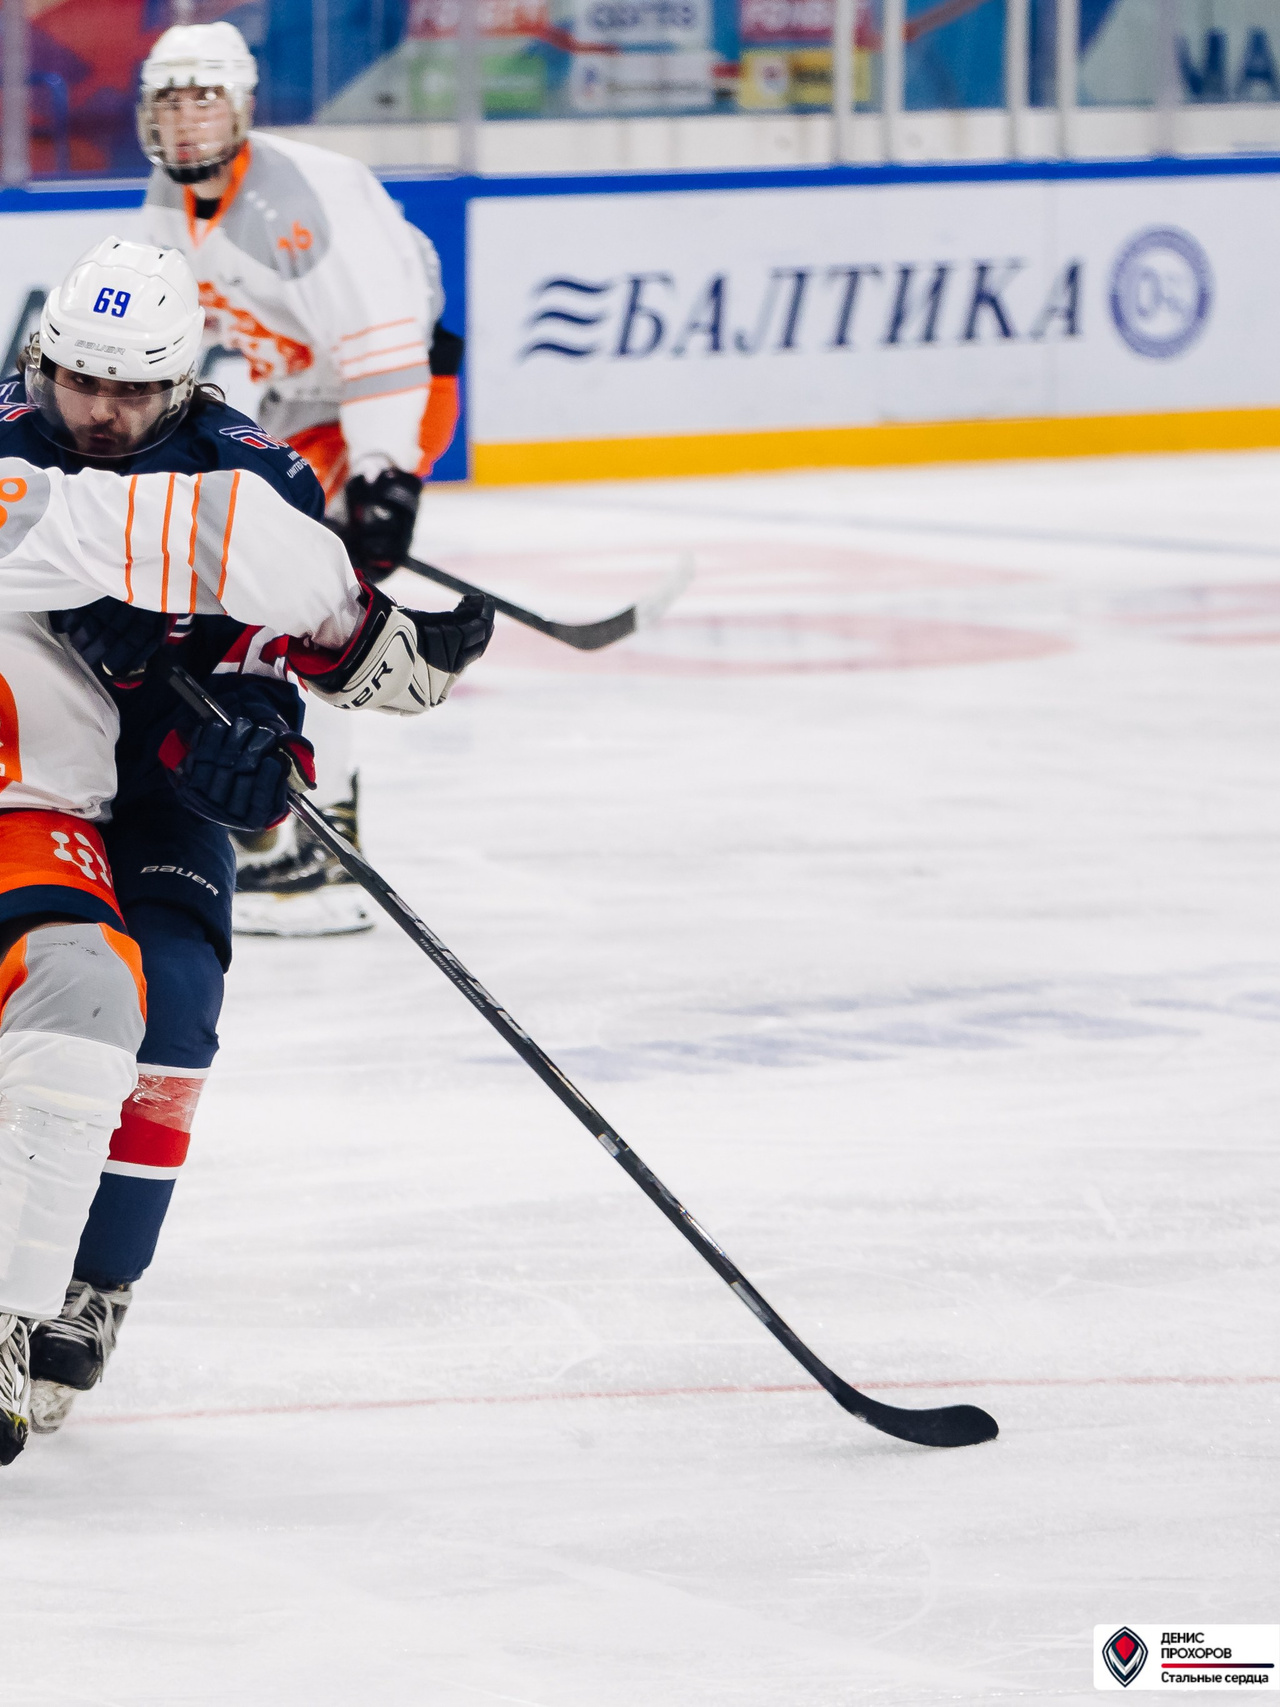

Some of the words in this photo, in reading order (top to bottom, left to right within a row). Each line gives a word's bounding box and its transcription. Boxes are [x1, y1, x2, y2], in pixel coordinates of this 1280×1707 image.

[92, 286, 132, 319] 69
[612, 257, 1084, 360] БАЛТИКА
[140, 865, 219, 897] BAUER
